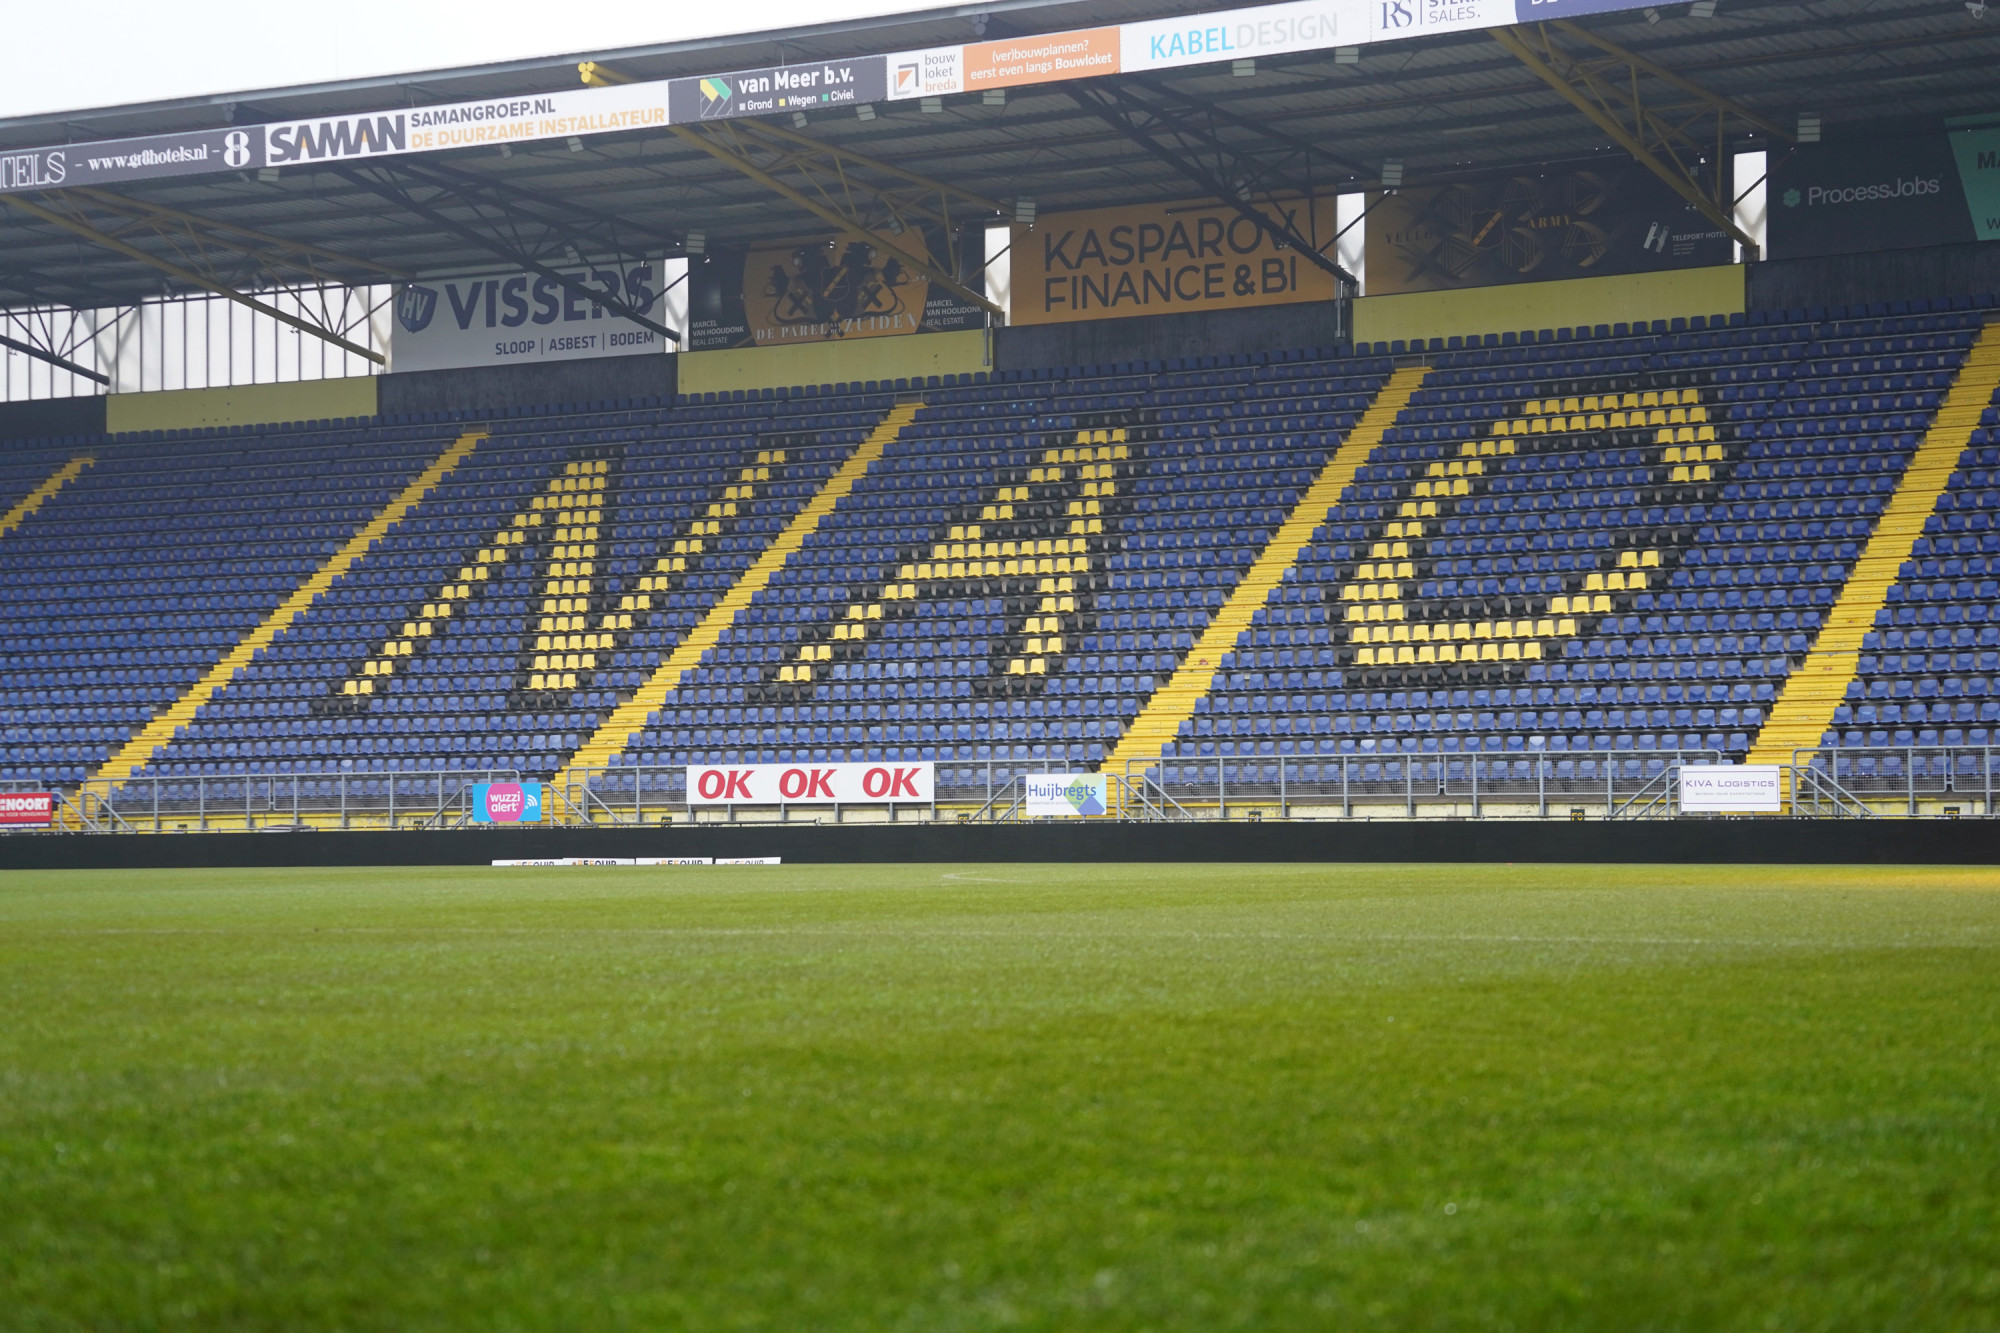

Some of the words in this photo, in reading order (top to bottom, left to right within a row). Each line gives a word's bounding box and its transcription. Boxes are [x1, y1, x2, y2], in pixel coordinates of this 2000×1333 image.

[1429, 6, 1481, 24] SALES.
[1150, 12, 1338, 60] KABELDESIGN
[925, 53, 956, 66] bouw
[992, 39, 1089, 64] (ver)bouwplannen?
[925, 66, 953, 79] loket
[970, 66, 996, 80] eerst
[999, 64, 1023, 77] even
[1026, 59, 1052, 75] langs
[1055, 53, 1112, 70] Bouwloket
[738, 77, 769, 94] van
[774, 69, 820, 91] Meer
[824, 66, 854, 85] b.v.
[925, 79, 957, 93] breda
[747, 97, 773, 111] Grond
[788, 94, 817, 109] Wegen
[831, 88, 854, 102] Civiel
[411, 98, 556, 128] SAMANGROEP.NL
[411, 131, 433, 149] DE
[438, 121, 534, 146] DUURZAME
[539, 107, 665, 135] INSTALLATEUR
[269, 114, 406, 163] SAMAN
[88, 143, 208, 170] www.gr8hotels.nl
[1808, 176, 1940, 206] ProcessJobs
[1527, 214, 1573, 230] ARMY
[1672, 232, 1705, 242] TELEPORT
[1045, 262, 1226, 312] FINANCE
[1261, 255, 1297, 295] BI
[445, 265, 655, 330] VISSERS
[927, 299, 953, 308] MARCEL
[927, 308, 940, 316] VAN
[927, 318, 941, 326] REAL
[942, 316, 965, 325] ESTATE
[692, 319, 717, 329] MARCEL
[844, 311, 918, 333] ZUIDEN
[692, 329, 706, 337] VAN
[756, 328, 775, 340] DE
[781, 323, 827, 338] PAREL
[495, 340, 535, 355] SLOOP
[549, 335, 597, 351] ASBEST
[610, 331, 655, 347] BODEM
[692, 338, 707, 346] REAL
[707, 336, 728, 345] ESTATE
[697, 769, 755, 799] OK
[779, 768, 837, 799] OK
[862, 767, 922, 797] OK
[1028, 782, 1097, 801] Huijbregts
[1685, 779, 1713, 787] KIVA
[490, 790, 521, 802] wuzzi
[491, 802, 517, 812] alert
